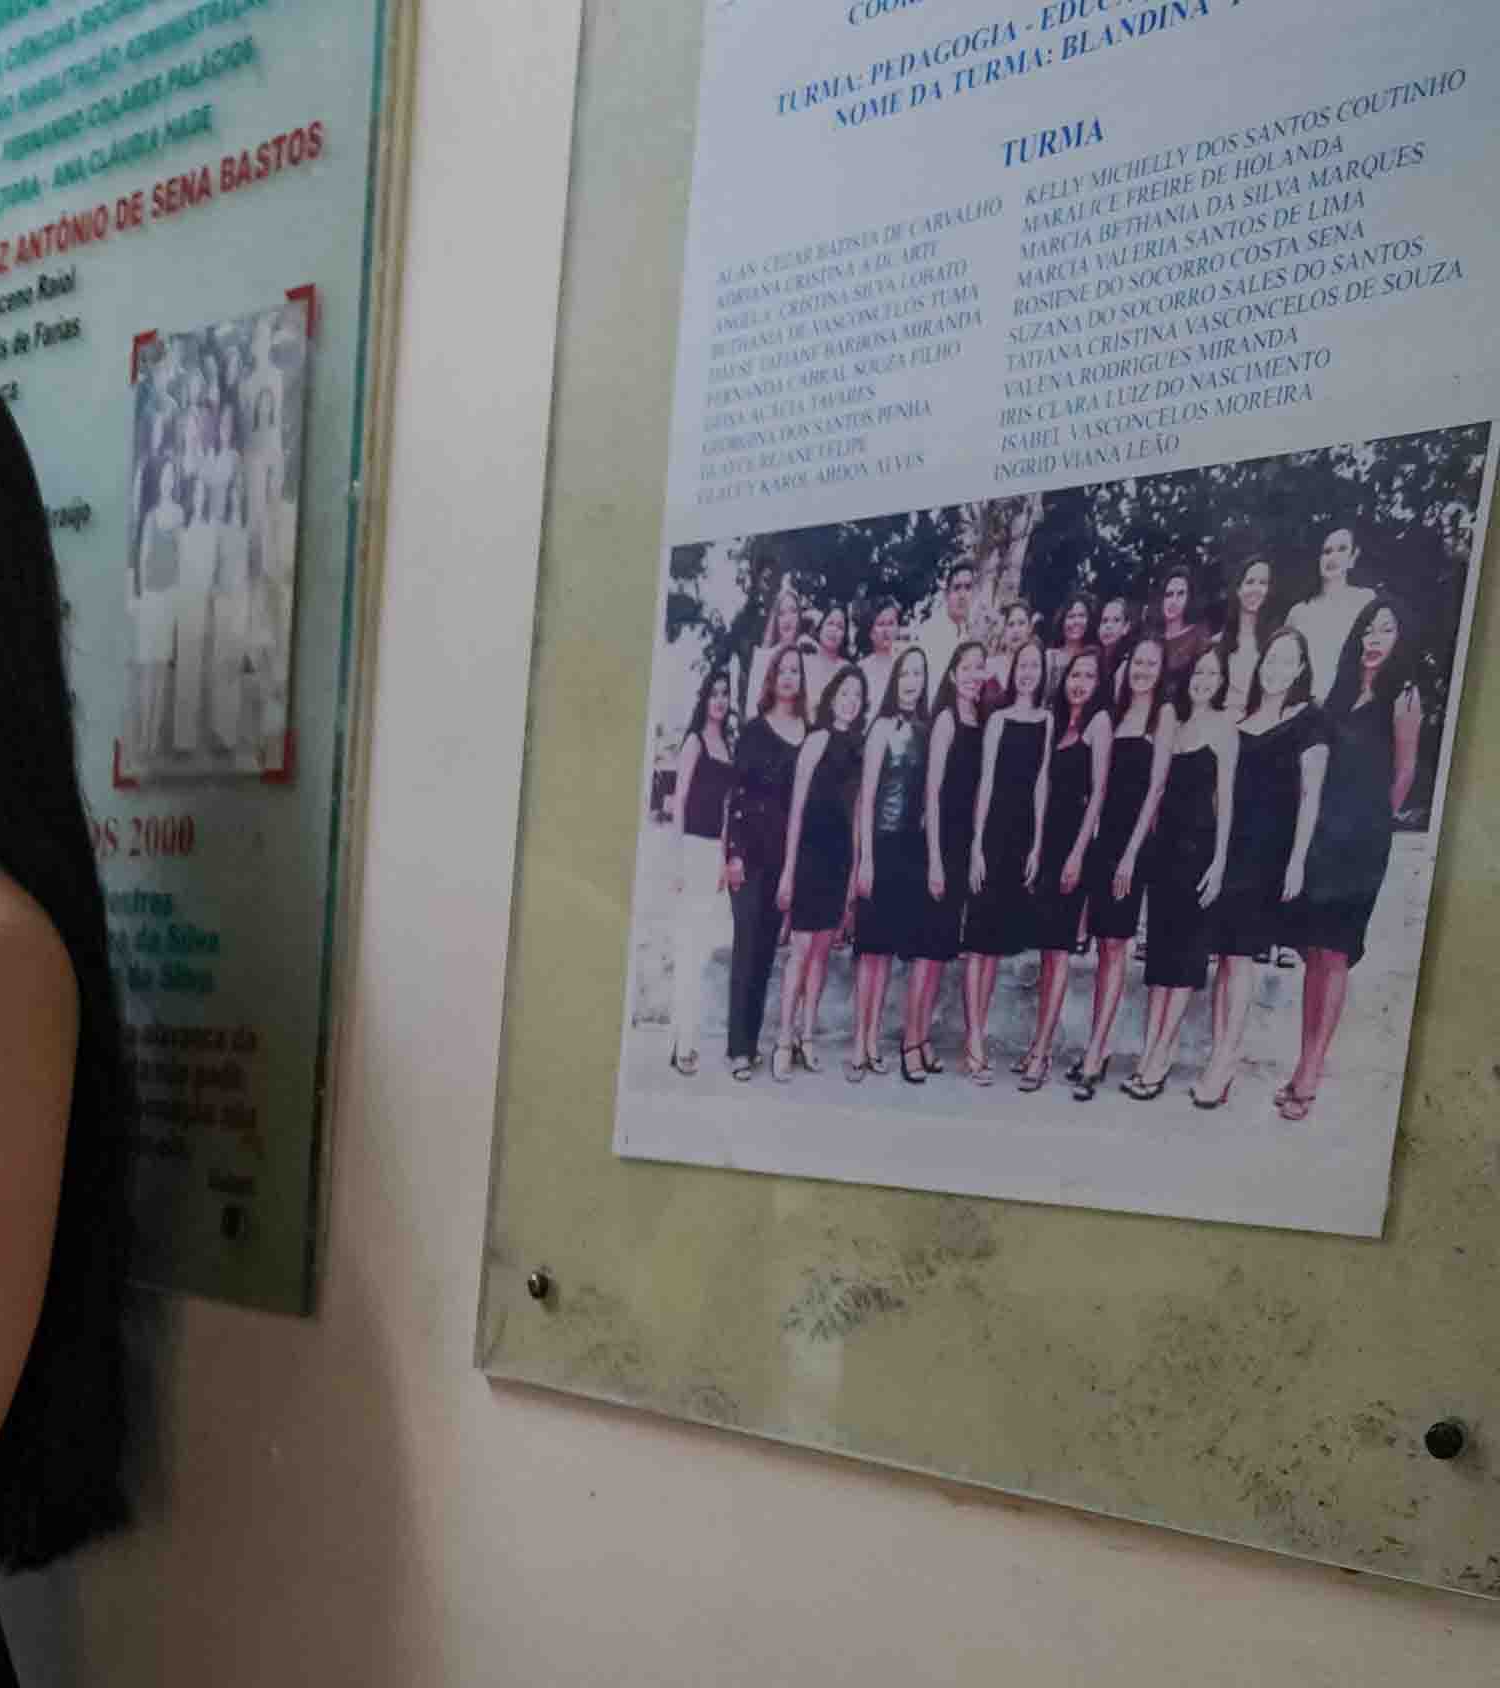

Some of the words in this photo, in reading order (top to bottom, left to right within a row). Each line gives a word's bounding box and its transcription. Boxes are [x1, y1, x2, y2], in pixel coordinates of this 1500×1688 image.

[777, 73, 863, 115] TURMA:
[870, 20, 1018, 87] PEDAGOGIA
[831, 91, 901, 130] NOME
[910, 79, 943, 108] DA
[952, 47, 1053, 95] TURMA:
[1060, 0, 1211, 61] BLANDINA
[1001, 116, 1104, 169] TURMA
[1196, 131, 1240, 163] DOS
[1244, 106, 1334, 148] SANTOS
[1336, 67, 1468, 124] COUTINHO
[114, 190, 146, 233] DE
[149, 163, 214, 222] SENA
[218, 119, 325, 193] BASTOS
[1020, 225, 1092, 261] MARCIA
[1205, 188, 1237, 218] DA
[1243, 171, 1301, 208] SILVA
[1306, 140, 1427, 191] MARQUES
[1119, 173, 1196, 209] FREIRE
[1201, 161, 1229, 188] DE
[1234, 135, 1345, 181] HOLANDA
[908, 197, 1005, 238] CARVALHO
[1183, 212, 1268, 251] SANTOS
[1273, 203, 1301, 228] DE
[1306, 188, 1366, 222] LIMA
[1008, 314, 1083, 347] SUZANA
[1087, 304, 1116, 329] DO
[1118, 282, 1218, 324] SOCORRO
[1220, 266, 1288, 299] SALES
[1292, 256, 1327, 283] DO
[1331, 234, 1426, 275] SANTOS
[1096, 276, 1124, 300] DO
[1127, 253, 1225, 293] SOCORRO
[1228, 239, 1302, 270] COSTA
[1306, 219, 1366, 251] SENA
[1087, 322, 1179, 359] CRISTINA
[1184, 284, 1340, 337] VASCONCELOS
[1343, 278, 1377, 306] DE
[1379, 258, 1466, 297] SOUZA
[1035, 393, 1101, 422] CLARA
[1153, 375, 1186, 399] DO
[1188, 346, 1333, 393] NASCIMENTO
[1078, 346, 1194, 386] RODRIGUES
[1197, 324, 1300, 361] MIRANDA
[1067, 400, 1210, 442] VASCONCELOS
[1210, 381, 1315, 417] MOREIRA
[992, 452, 1057, 484] INGRID
[1060, 443, 1122, 470] VIANA
[1124, 432, 1182, 462] LEÃO
[128, 814, 196, 858] 2000
